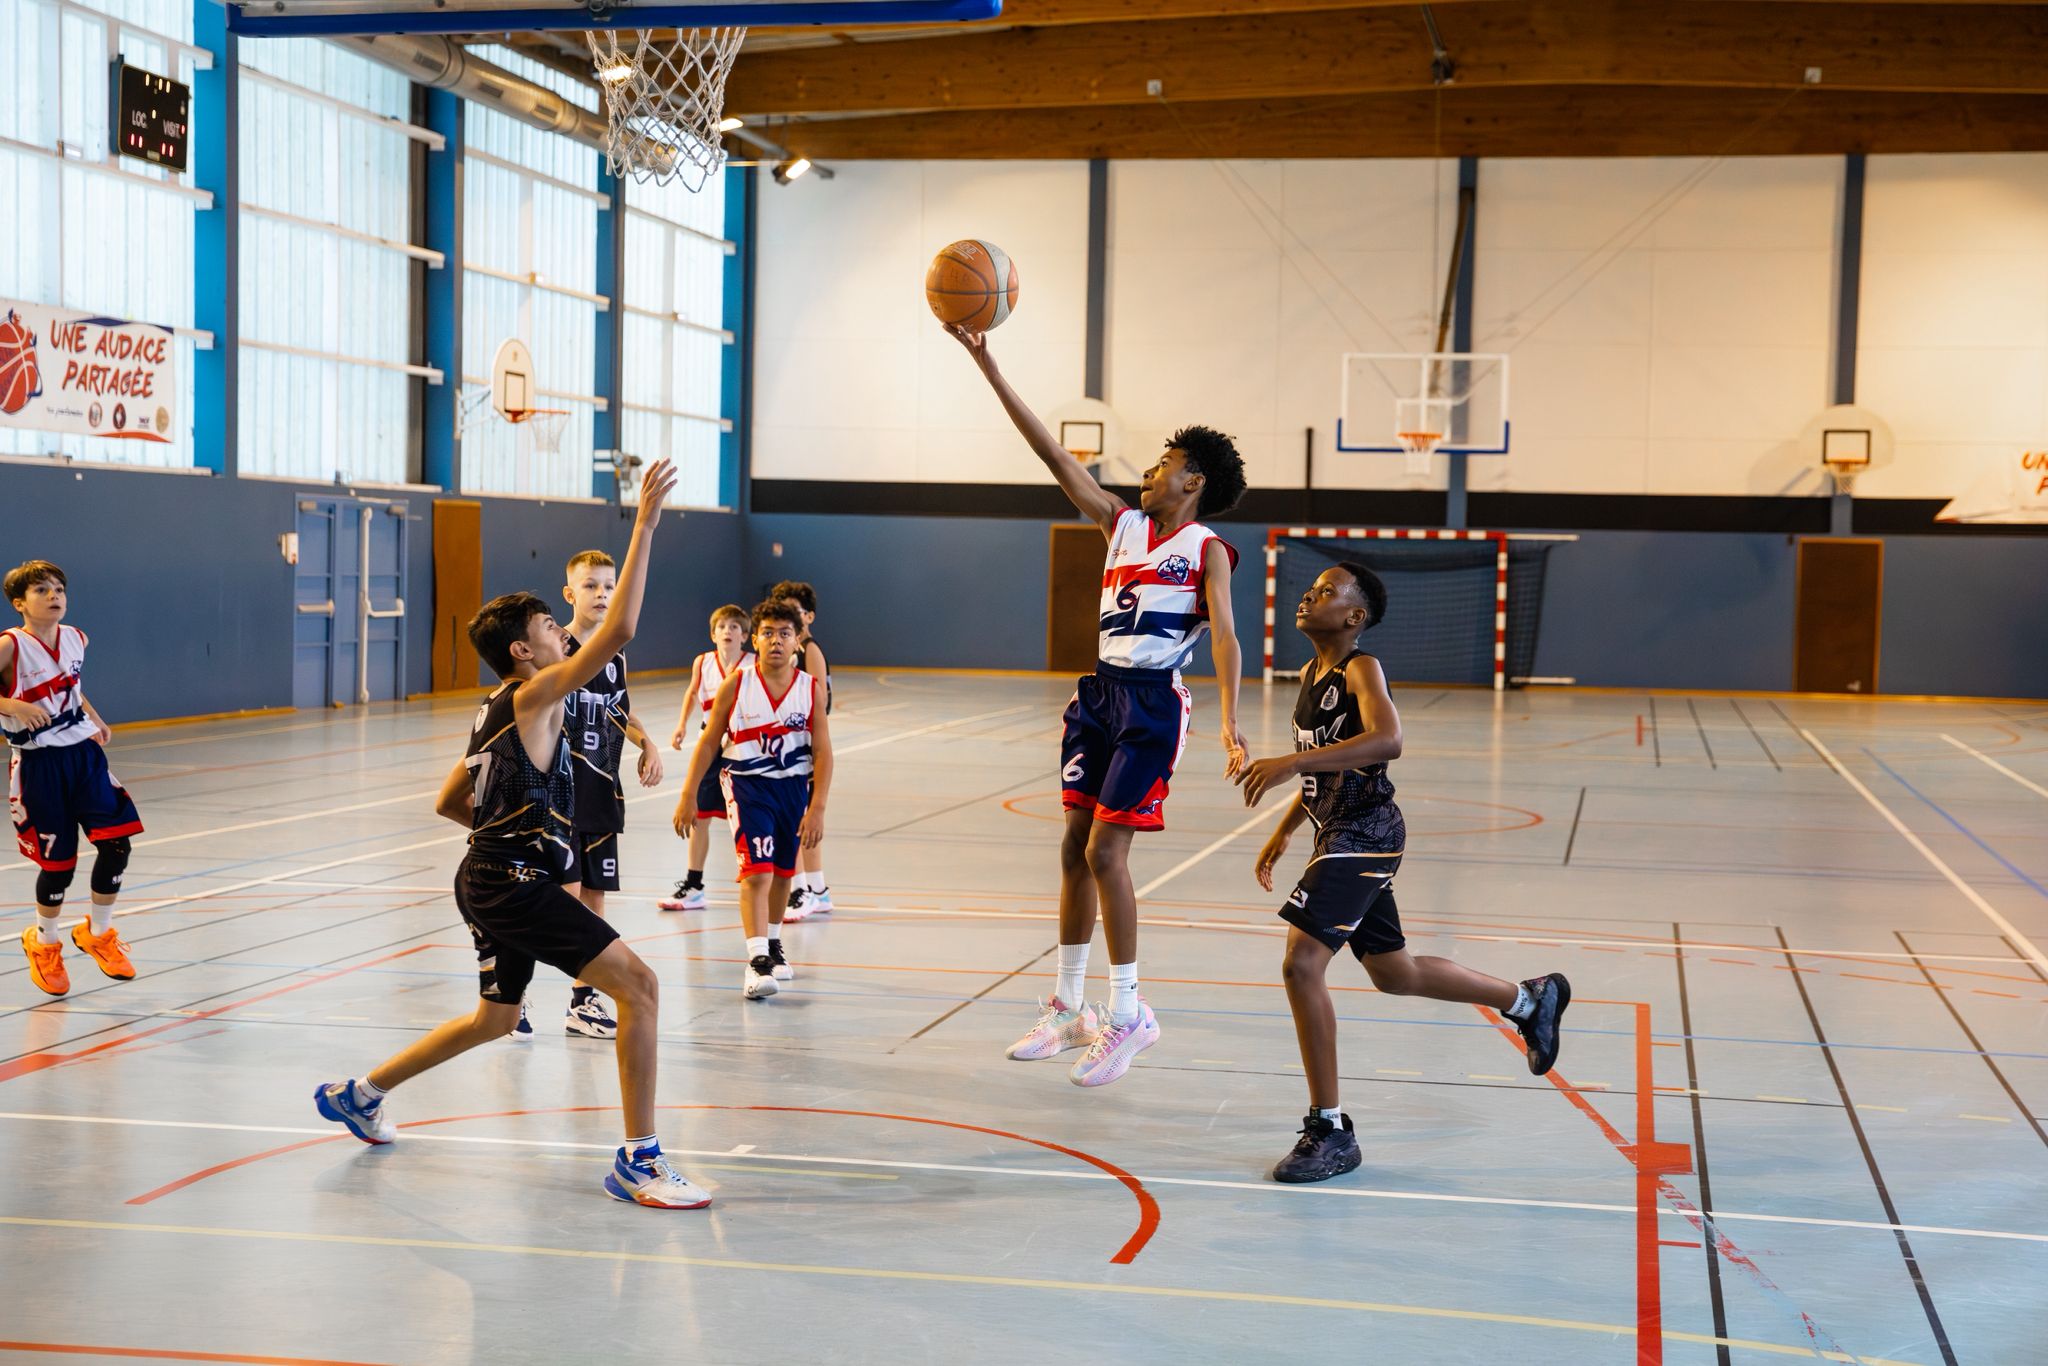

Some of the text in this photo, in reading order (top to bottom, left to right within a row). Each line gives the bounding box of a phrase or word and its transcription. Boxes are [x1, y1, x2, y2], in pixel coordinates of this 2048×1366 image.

[50, 319, 167, 364] UNE AUDACE
[62, 360, 154, 398] PARTAGÉE
[1116, 580, 1140, 610] 6
[54, 680, 73, 713] 7
[583, 730, 600, 751] 9
[761, 732, 785, 756] 10
[465, 751, 492, 808] 7
[1062, 753, 1085, 782] 6
[1301, 775, 1317, 798] 9
[39, 833, 57, 859] 7
[752, 835, 775, 858] 10
[602, 858, 616, 877] 9
